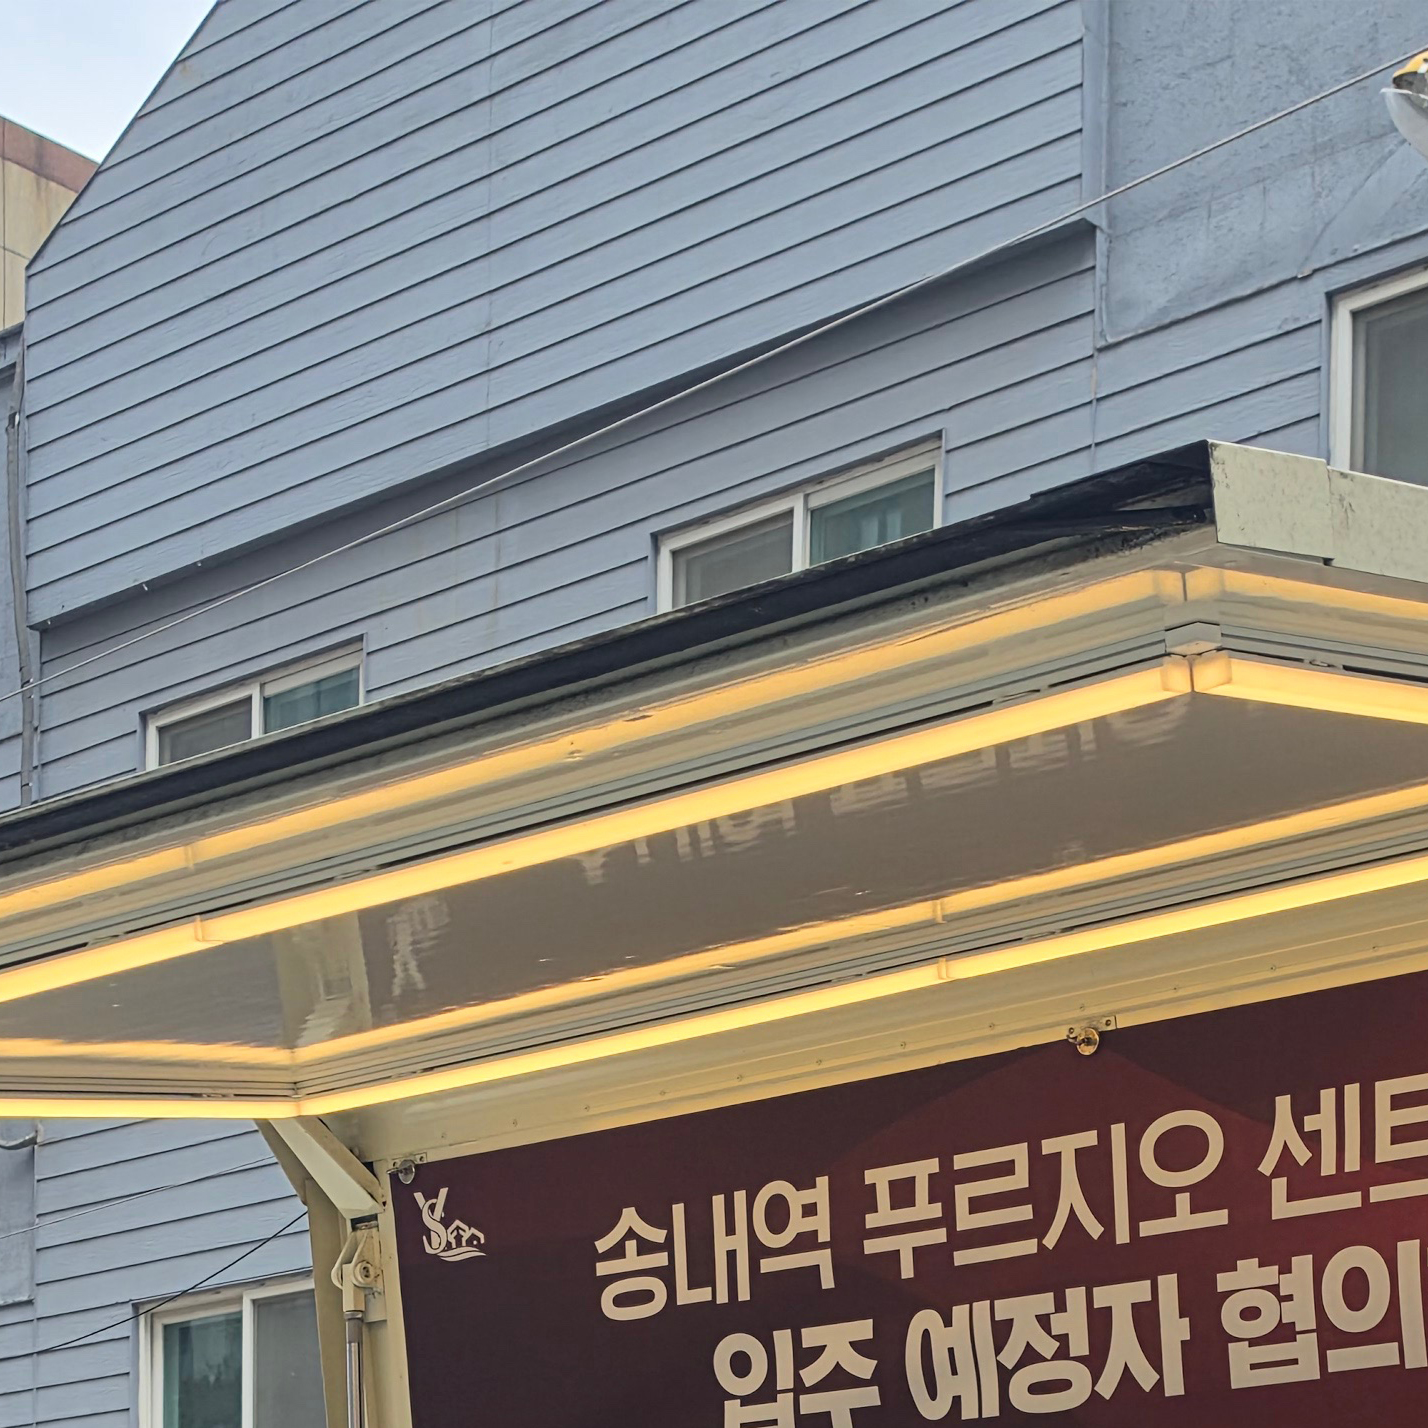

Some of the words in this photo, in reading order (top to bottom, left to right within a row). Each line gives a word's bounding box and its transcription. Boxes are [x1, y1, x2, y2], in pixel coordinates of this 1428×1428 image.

[594, 1176, 835, 1320] 송내역
[863, 1110, 1228, 1279] 푸르지오
[905, 1273, 1190, 1420] 예정자
